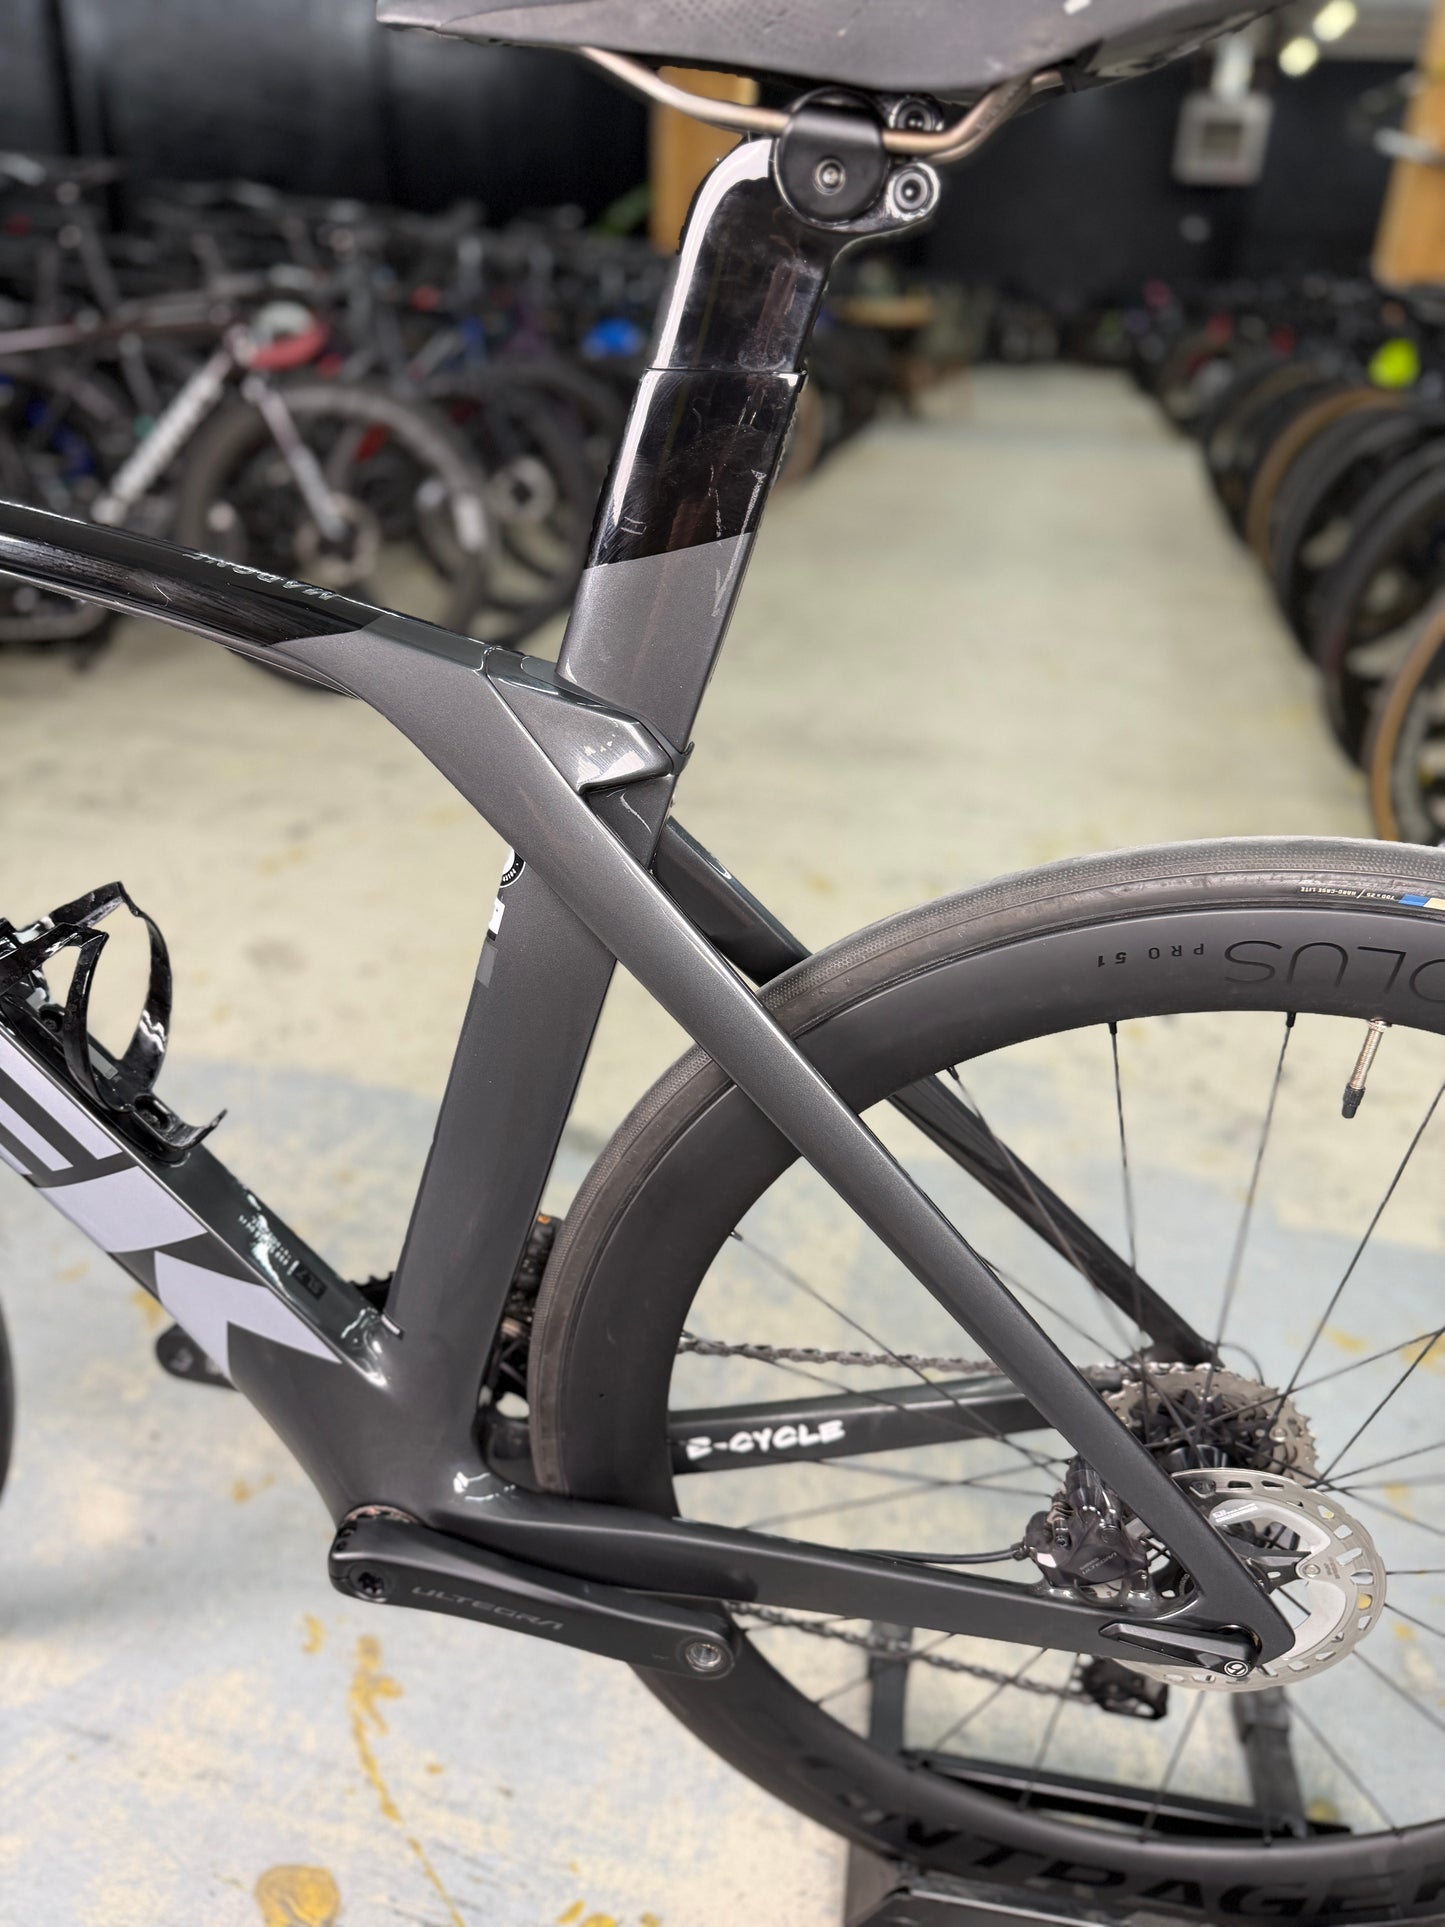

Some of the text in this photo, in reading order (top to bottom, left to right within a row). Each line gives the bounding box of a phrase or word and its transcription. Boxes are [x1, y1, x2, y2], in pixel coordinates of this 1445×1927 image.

[1097, 951, 1127, 968] 51
[1148, 943, 1204, 960] PRO
[411, 1586, 564, 1631] ULTEGRA
